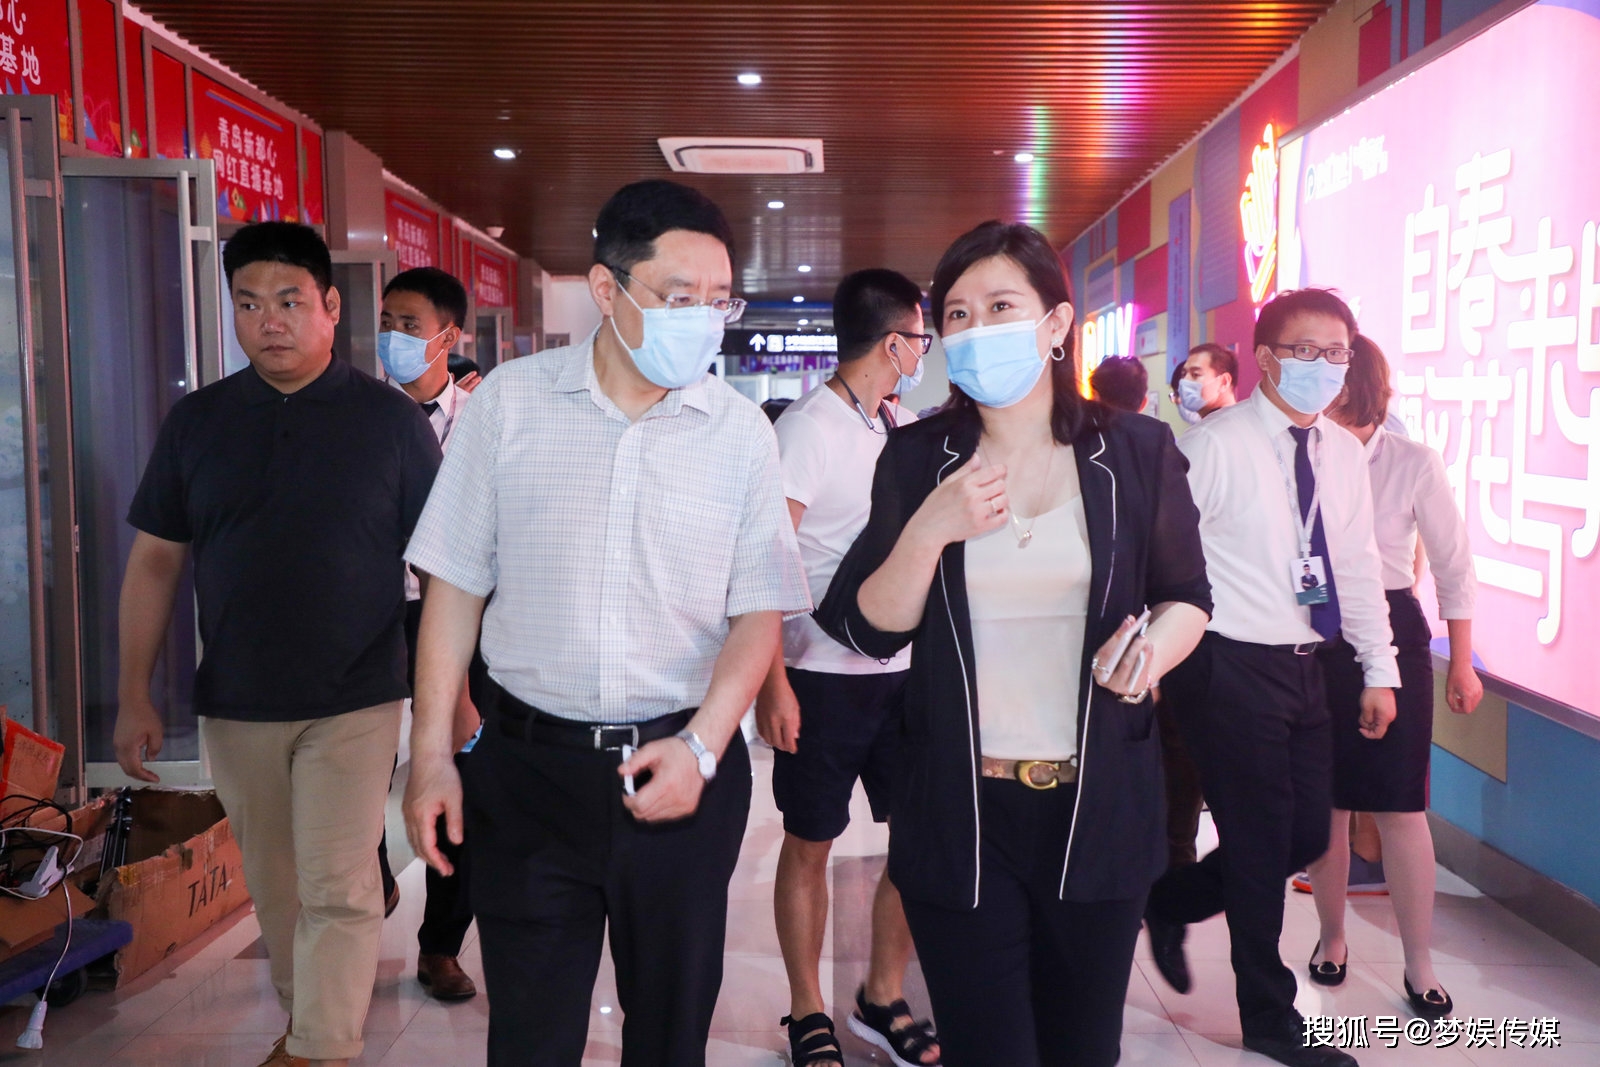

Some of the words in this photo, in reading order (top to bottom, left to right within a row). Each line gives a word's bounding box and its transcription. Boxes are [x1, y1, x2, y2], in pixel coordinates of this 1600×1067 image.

[0, 0, 27, 36] 心
[0, 32, 41, 86] 基地
[218, 116, 278, 169] 青岛新都心
[213, 148, 284, 201] 网红直播基地
[188, 862, 228, 918] TATA
